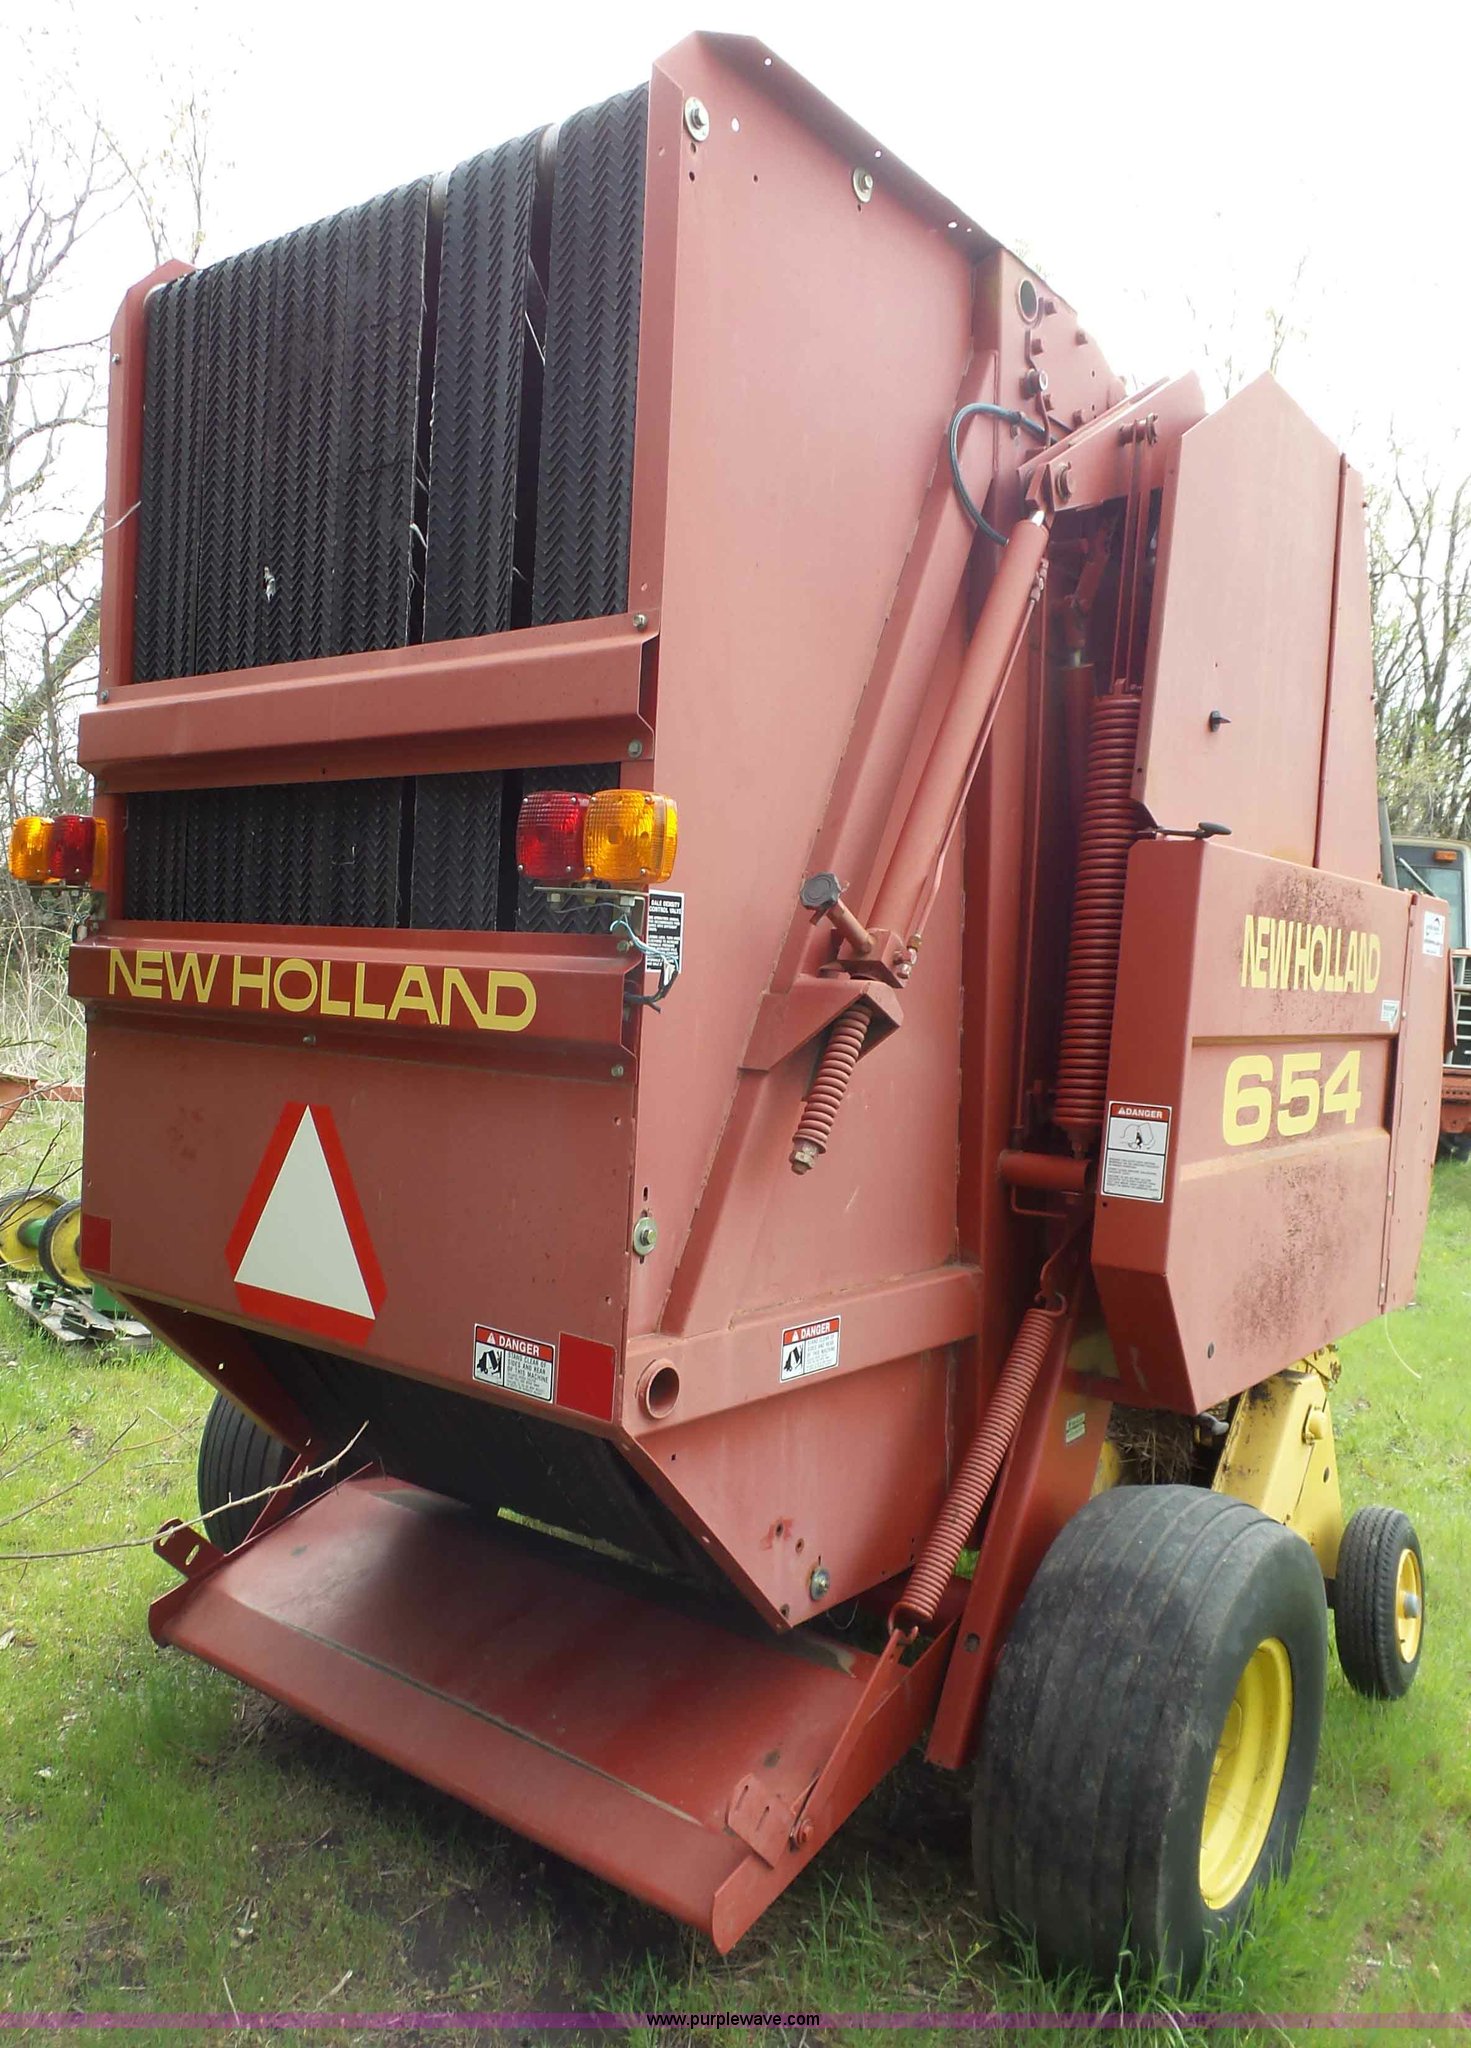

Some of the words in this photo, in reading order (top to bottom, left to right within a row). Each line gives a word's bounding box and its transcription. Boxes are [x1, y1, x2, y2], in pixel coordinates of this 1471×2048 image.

[1240, 914, 1294, 990] NEW
[1293, 922, 1381, 994] HOLLAND
[108, 948, 221, 1003] NEW
[231, 955, 538, 1032] HOLLAND
[1125, 1108, 1163, 1119] DANGER
[1222, 1050, 1363, 1146] 654
[499, 1335, 540, 1357] DANGER
[801, 1322, 831, 1340] DANGER
